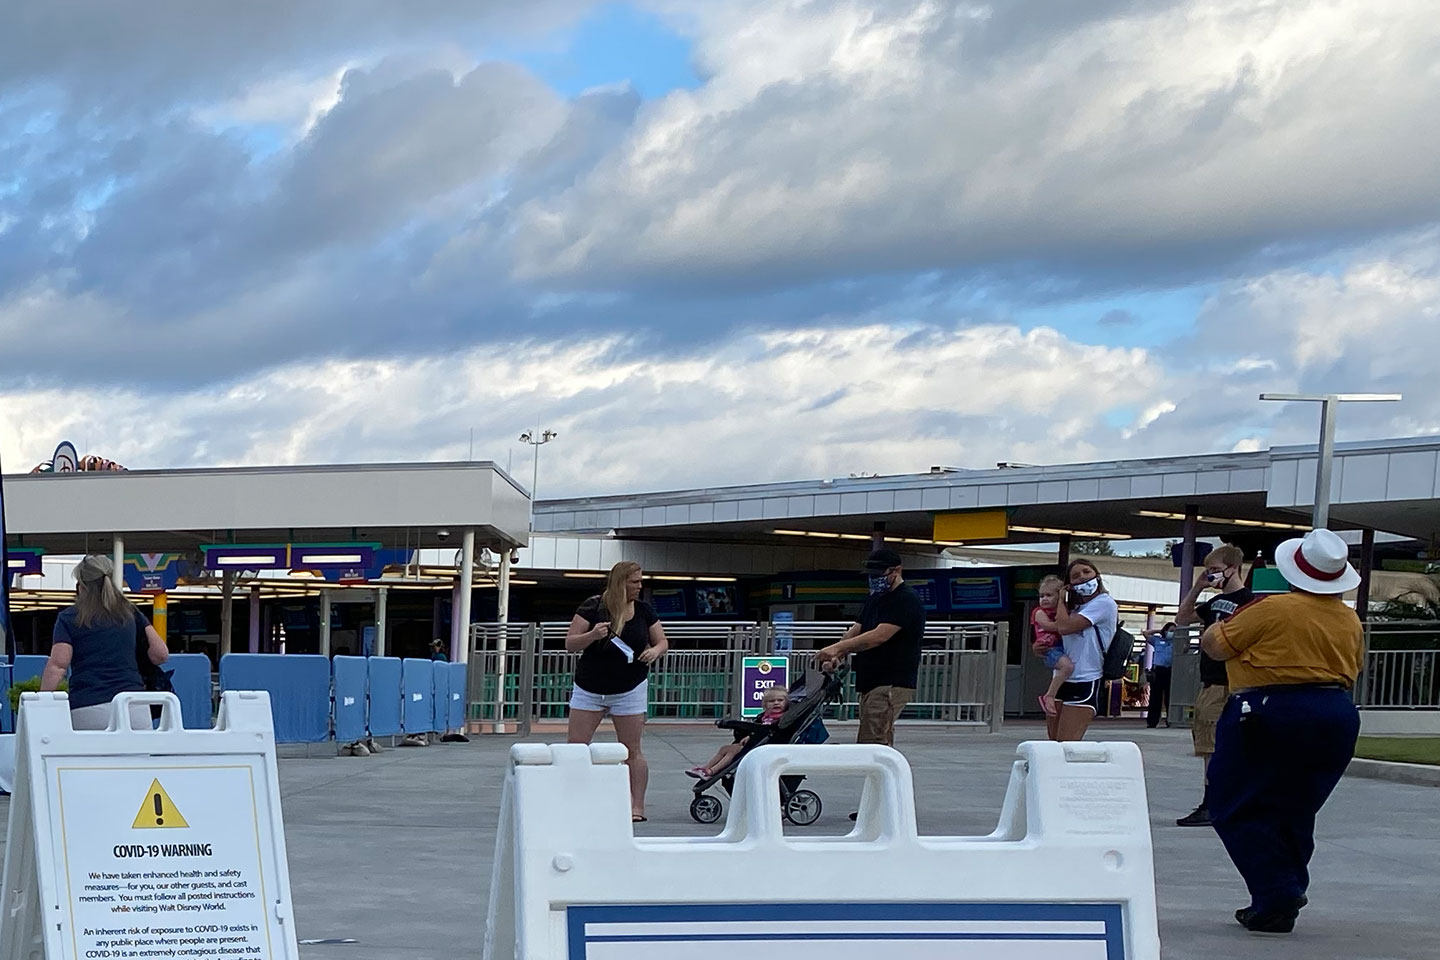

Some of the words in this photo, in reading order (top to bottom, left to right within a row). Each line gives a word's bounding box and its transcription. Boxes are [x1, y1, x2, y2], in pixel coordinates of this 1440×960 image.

[755, 680, 776, 689] EXIT
[753, 692, 766, 700] ON
[113, 845, 159, 858] COVID-19
[160, 843, 212, 857] WARNING
[142, 870, 179, 879] enhanced
[219, 868, 241, 878] safety
[190, 881, 216, 890] guests,
[187, 892, 212, 901] posted
[131, 905, 158, 914] visiting
[176, 903, 201, 912] Disney
[202, 902, 226, 910] World.
